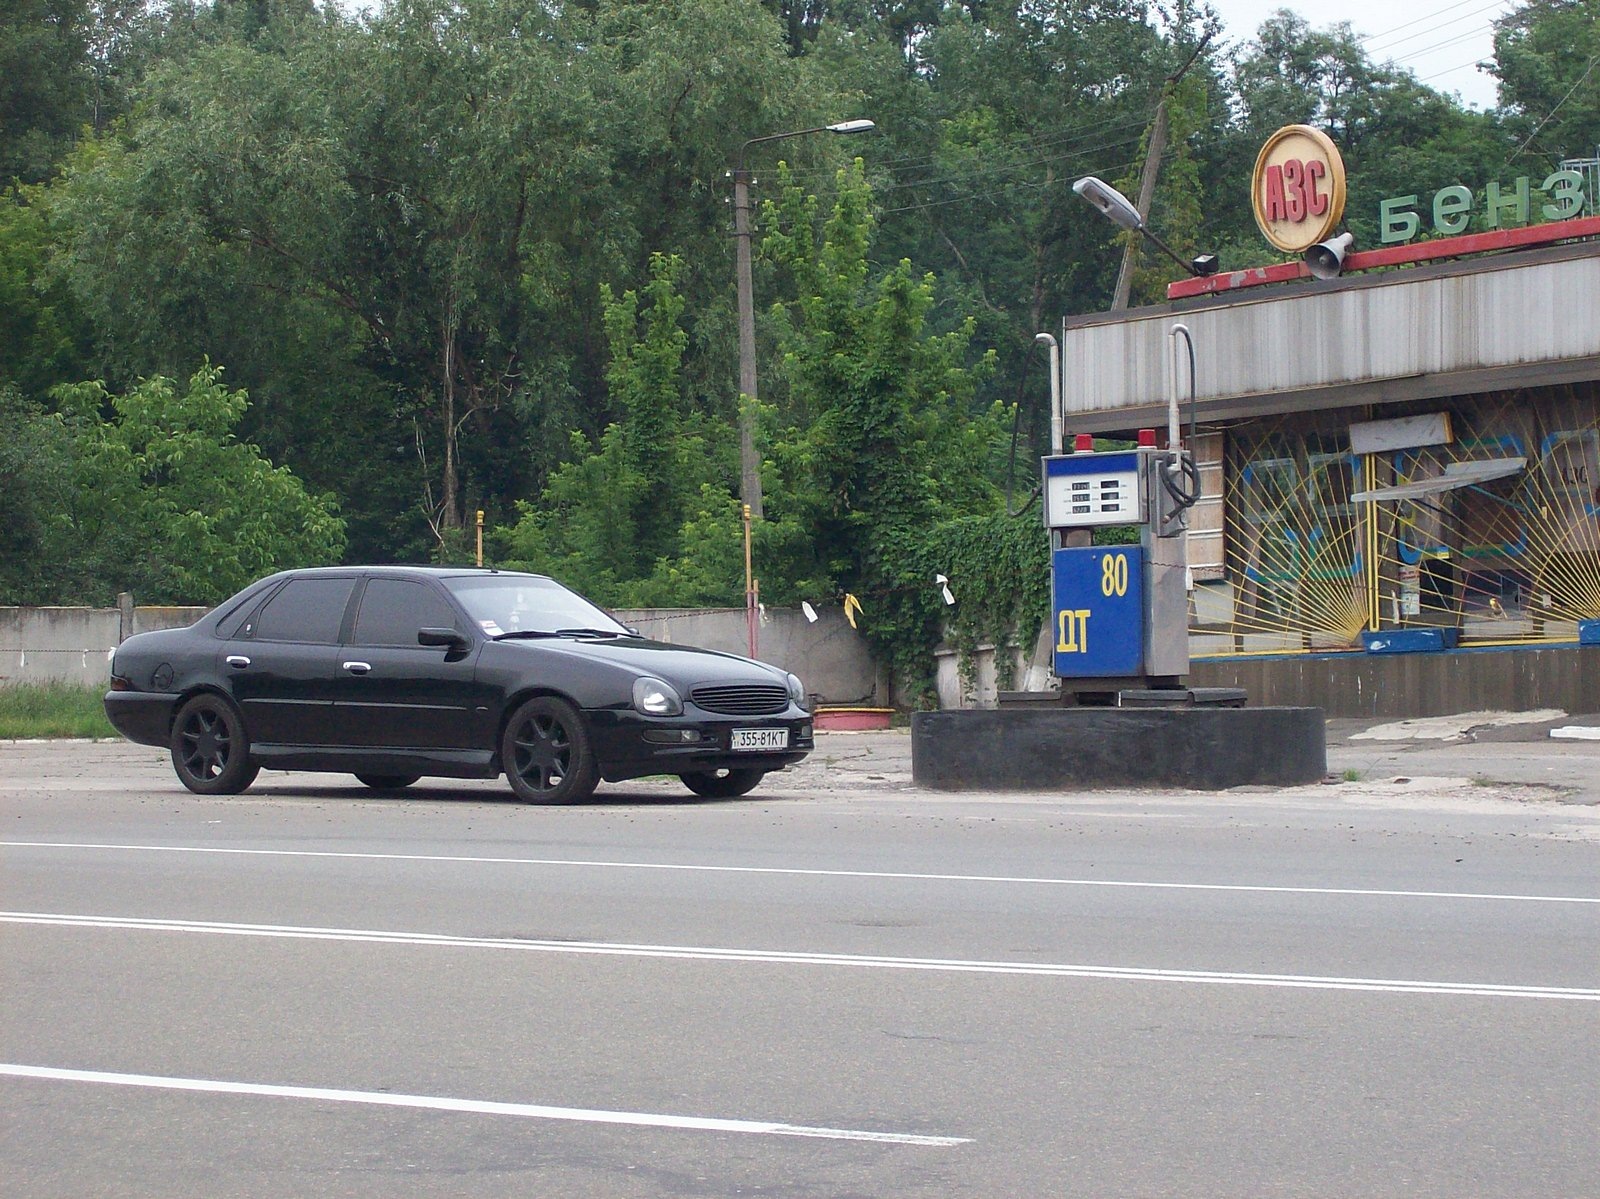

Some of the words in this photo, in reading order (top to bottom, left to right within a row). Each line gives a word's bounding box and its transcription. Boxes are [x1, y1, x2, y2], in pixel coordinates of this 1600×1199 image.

[1265, 159, 1328, 223] АЗС
[1102, 553, 1128, 597] 80
[1056, 609, 1091, 653] ДТ
